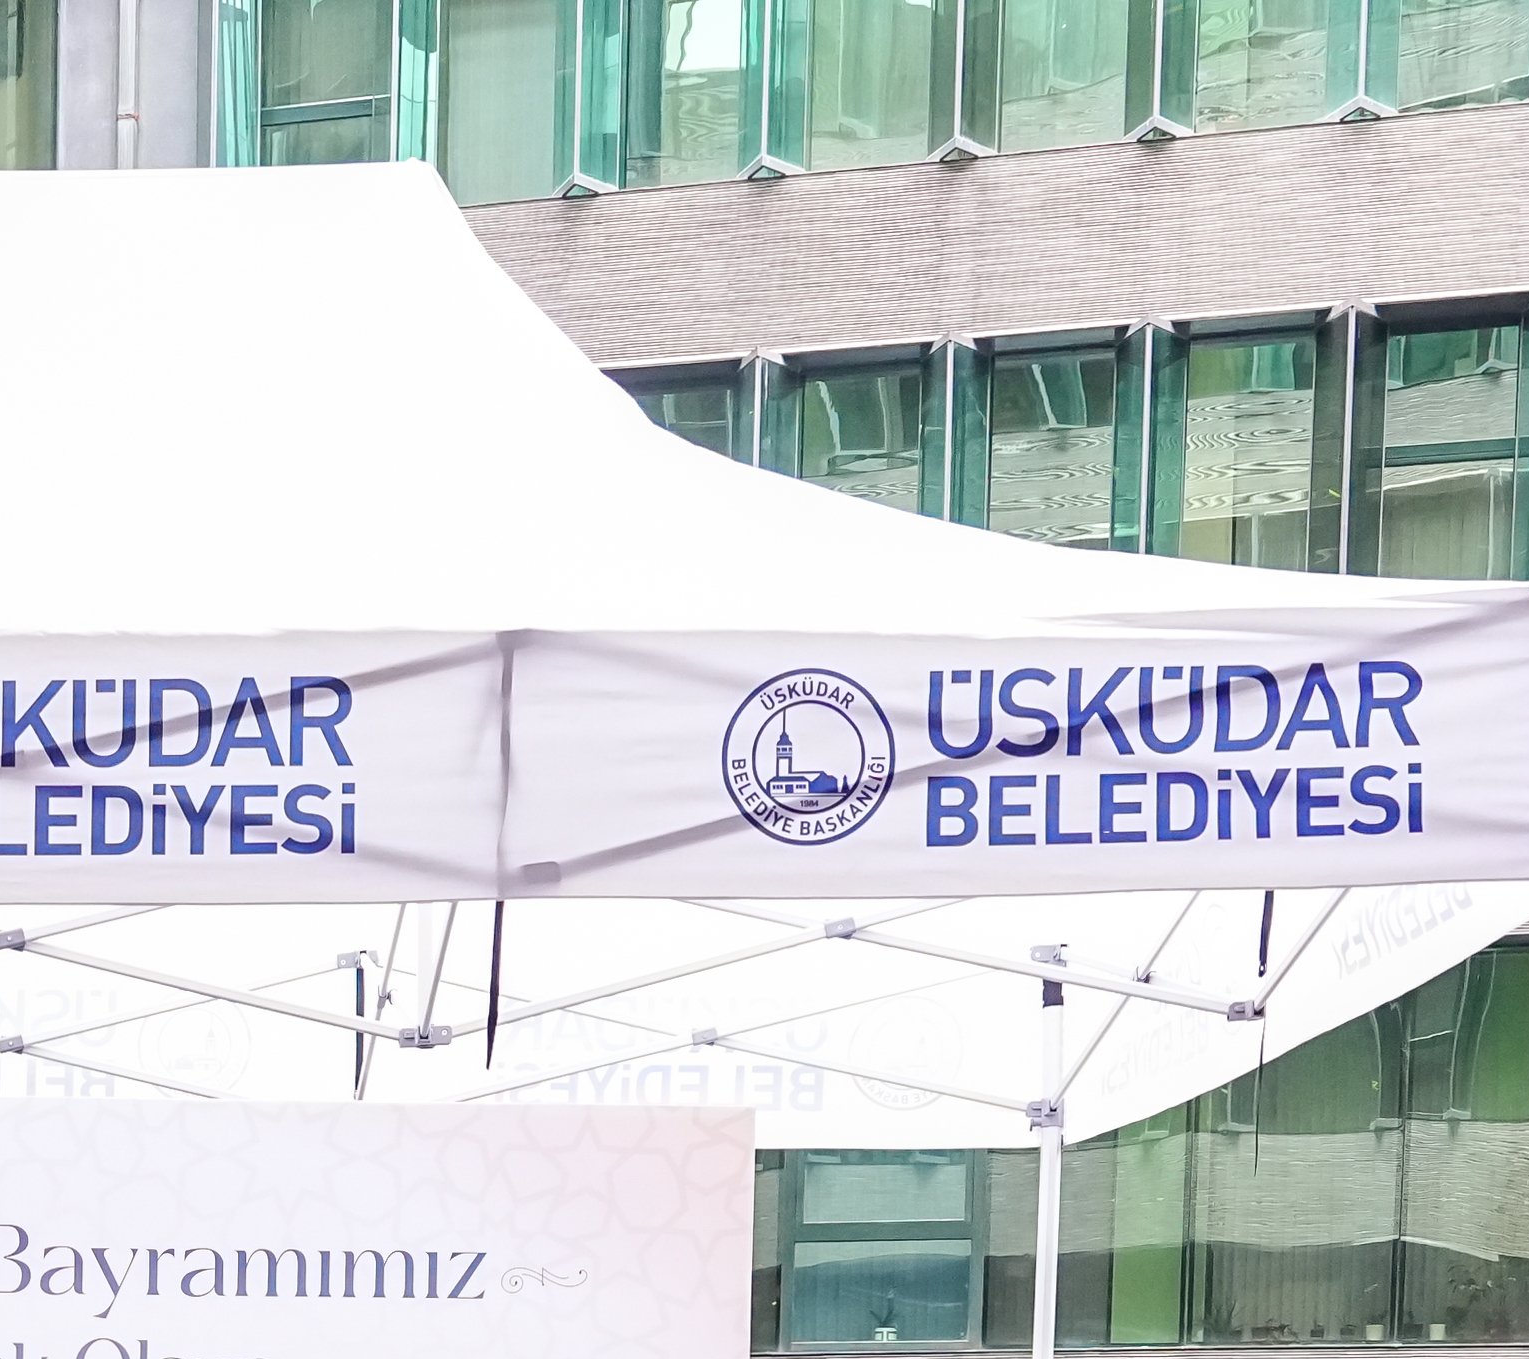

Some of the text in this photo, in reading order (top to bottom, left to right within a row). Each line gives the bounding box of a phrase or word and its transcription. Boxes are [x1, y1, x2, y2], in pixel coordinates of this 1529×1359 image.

[760, 677, 855, 710] ÜSKÜDAR
[928, 661, 1424, 759] ÜSKÜDAR
[731, 756, 886, 836] BELEDİYE BAŞKANLIĞI
